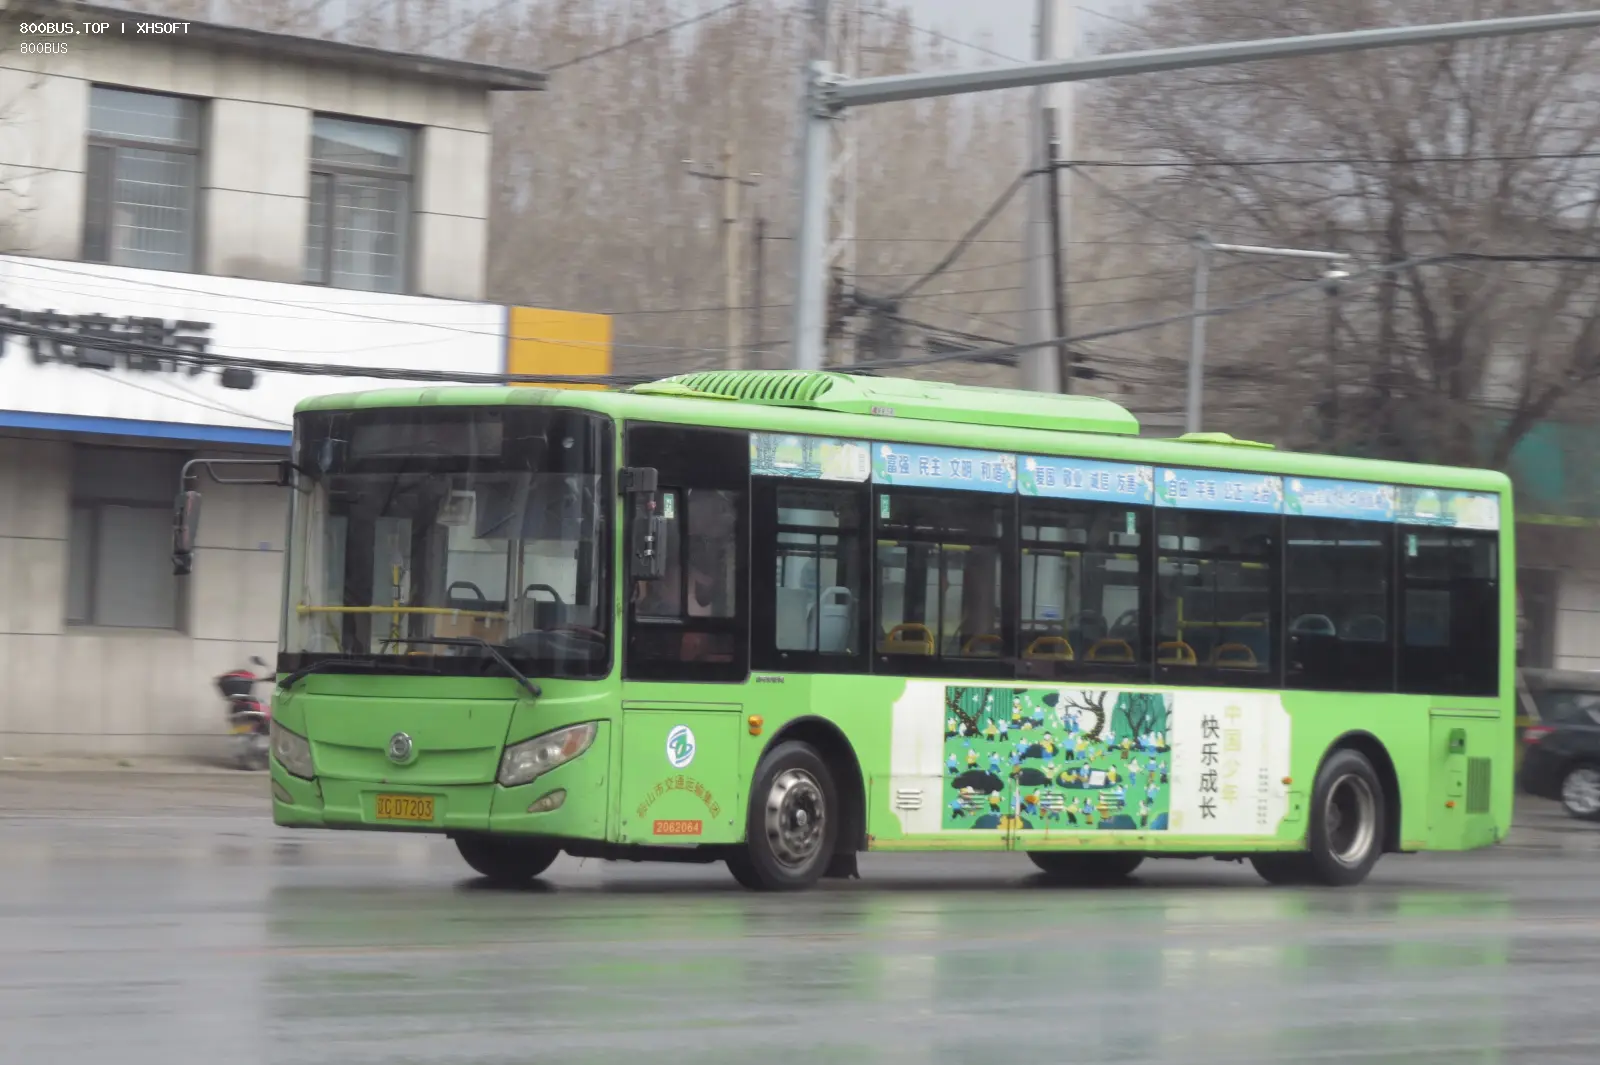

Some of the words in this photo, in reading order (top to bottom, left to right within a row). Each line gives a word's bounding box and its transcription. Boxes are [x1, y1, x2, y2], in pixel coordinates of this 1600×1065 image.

[887, 454, 910, 474] 富强
[919, 456, 941, 476] 民主
[950, 457, 972, 478] 文明
[981, 461, 1005, 482] 和谐
[1198, 714, 1220, 820] 快乐成长
[1221, 704, 1242, 805] 中国少年
[656, 821, 700, 834] 2062064
